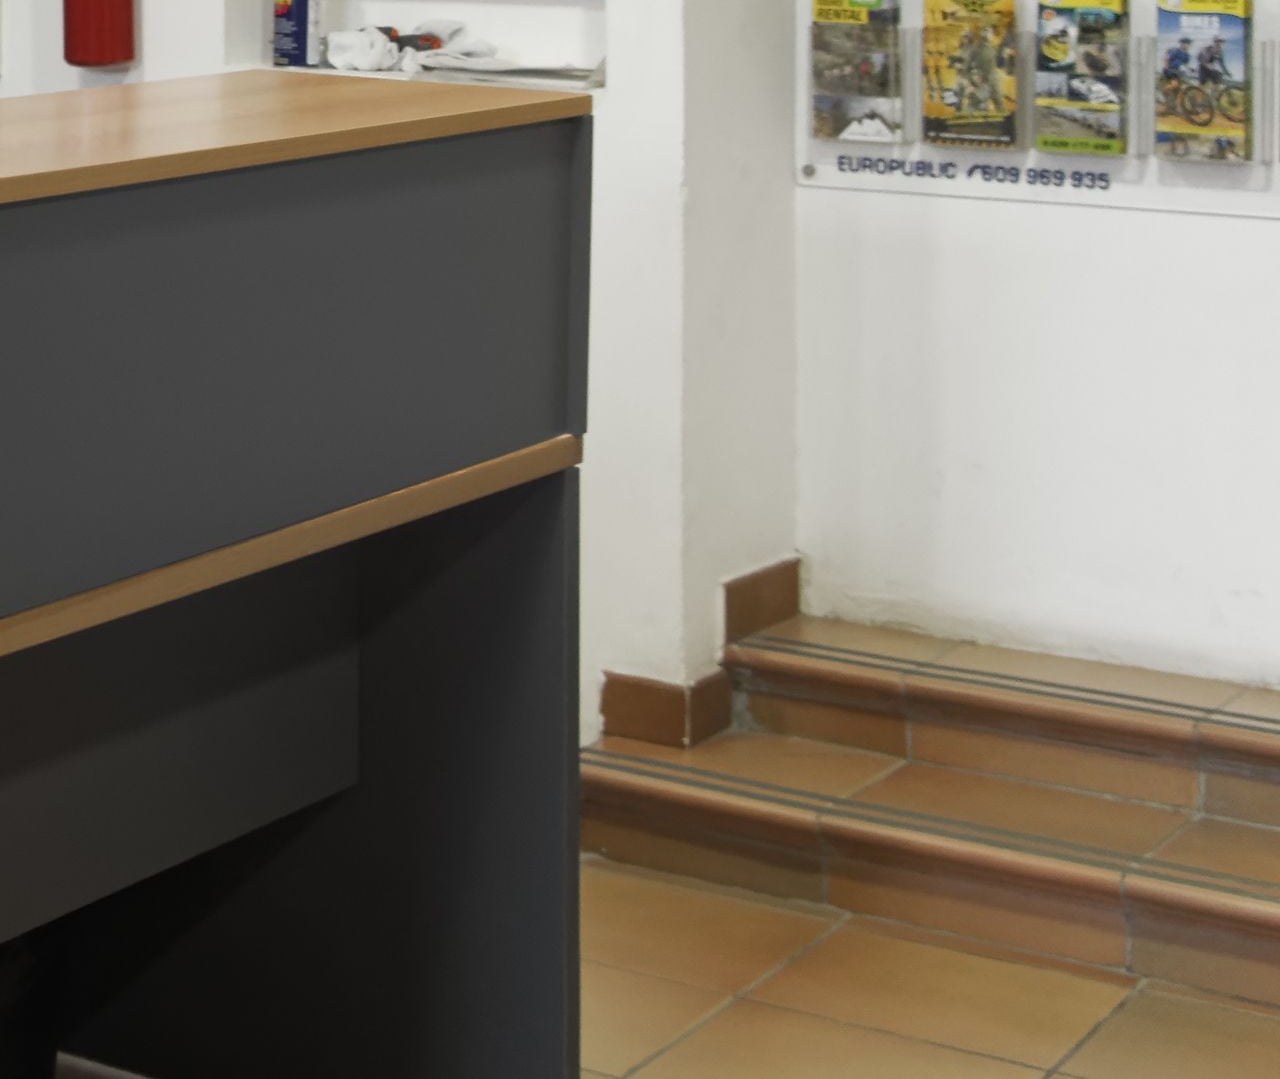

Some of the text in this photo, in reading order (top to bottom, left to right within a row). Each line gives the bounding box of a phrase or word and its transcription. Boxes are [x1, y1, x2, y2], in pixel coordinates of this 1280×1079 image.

[837, 155, 1110, 190] EUROPUBLIC 609 969 935
